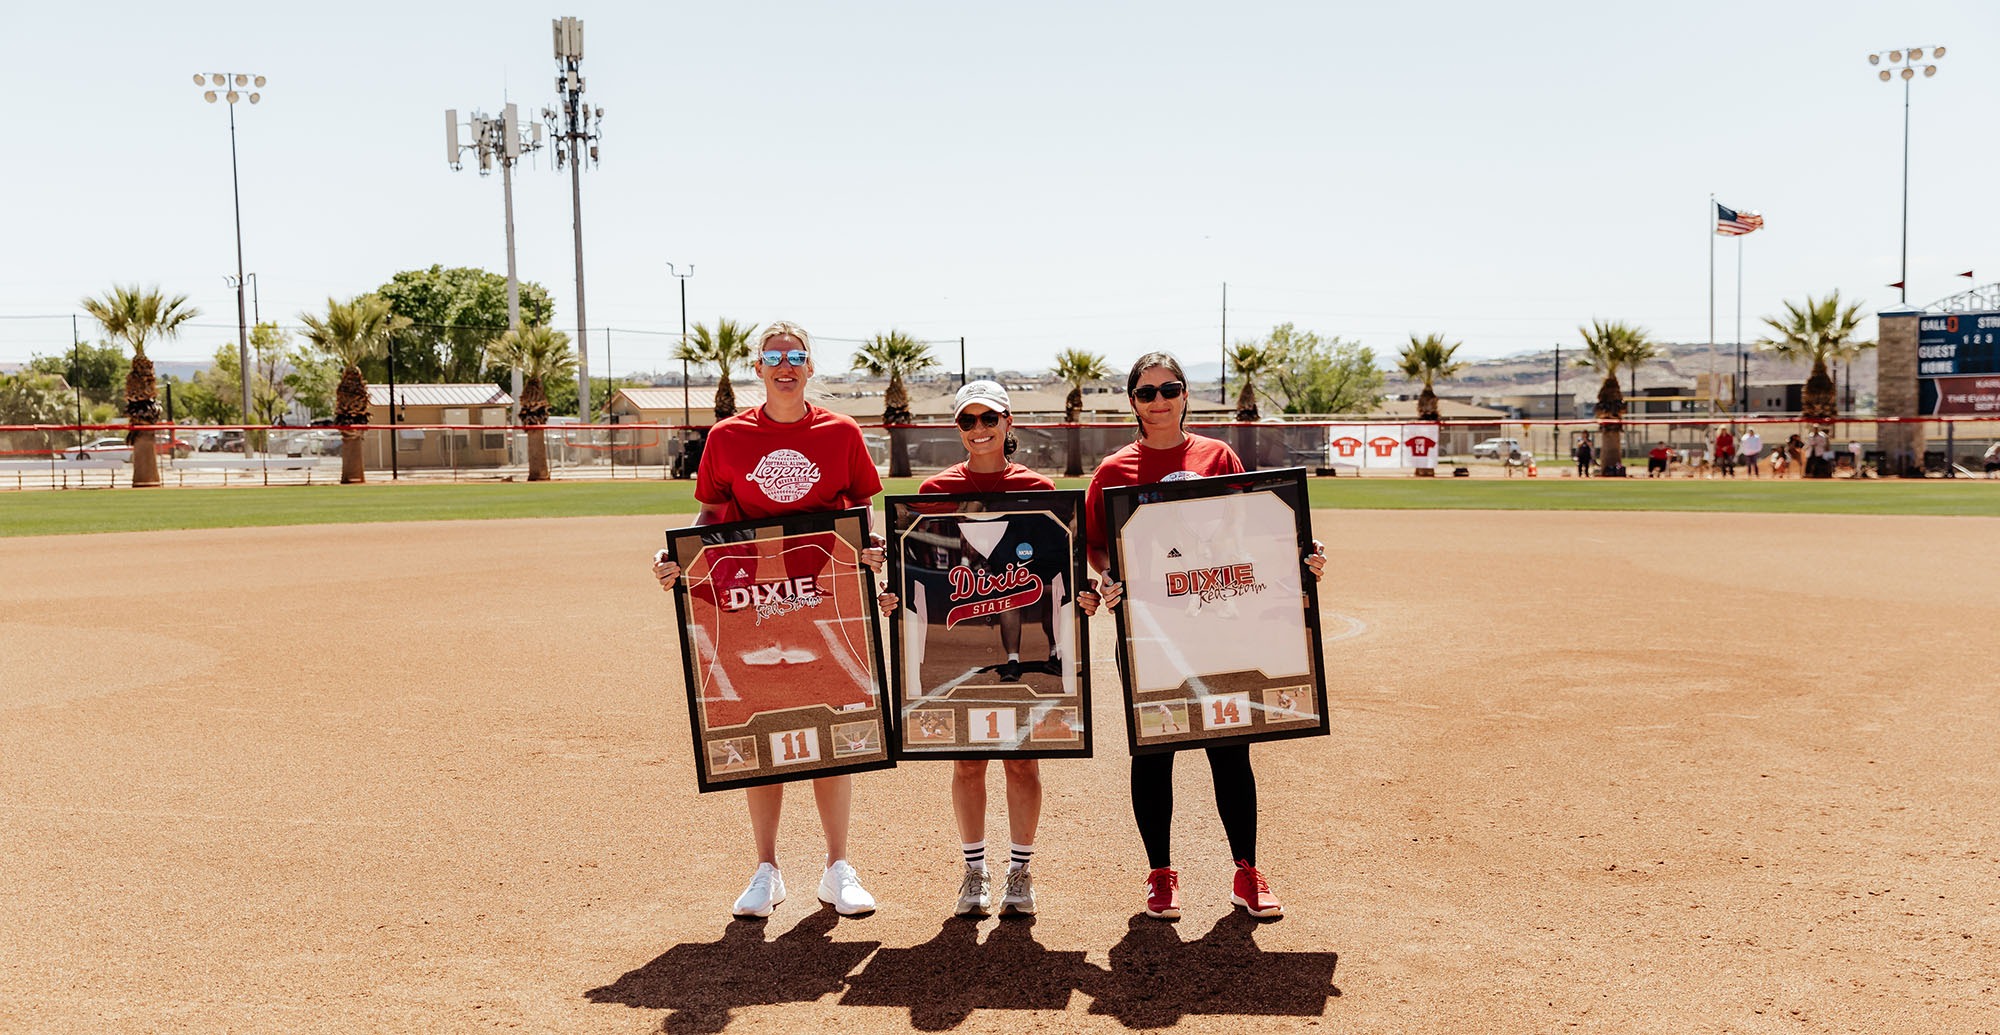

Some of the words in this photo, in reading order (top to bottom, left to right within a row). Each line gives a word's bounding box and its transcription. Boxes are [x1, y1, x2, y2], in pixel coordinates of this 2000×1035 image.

[1921, 319, 1947, 331] BALL
[1963, 334, 1969, 344] 1
[1973, 333, 1981, 344] 2
[1985, 333, 1993, 344] 3
[1919, 344, 1956, 358] GUEST
[1921, 361, 1953, 374] HOME
[1947, 394, 1966, 403] THE
[745, 456, 821, 488] Legends
[728, 575, 816, 611] DIXIE
[948, 563, 1030, 602] Dixie
[1165, 562, 1256, 597] DIXIE
[973, 598, 1013, 615] STATE
[985, 711, 1000, 739] 1
[1212, 698, 1240, 725] 14
[781, 731, 811, 761] 11
